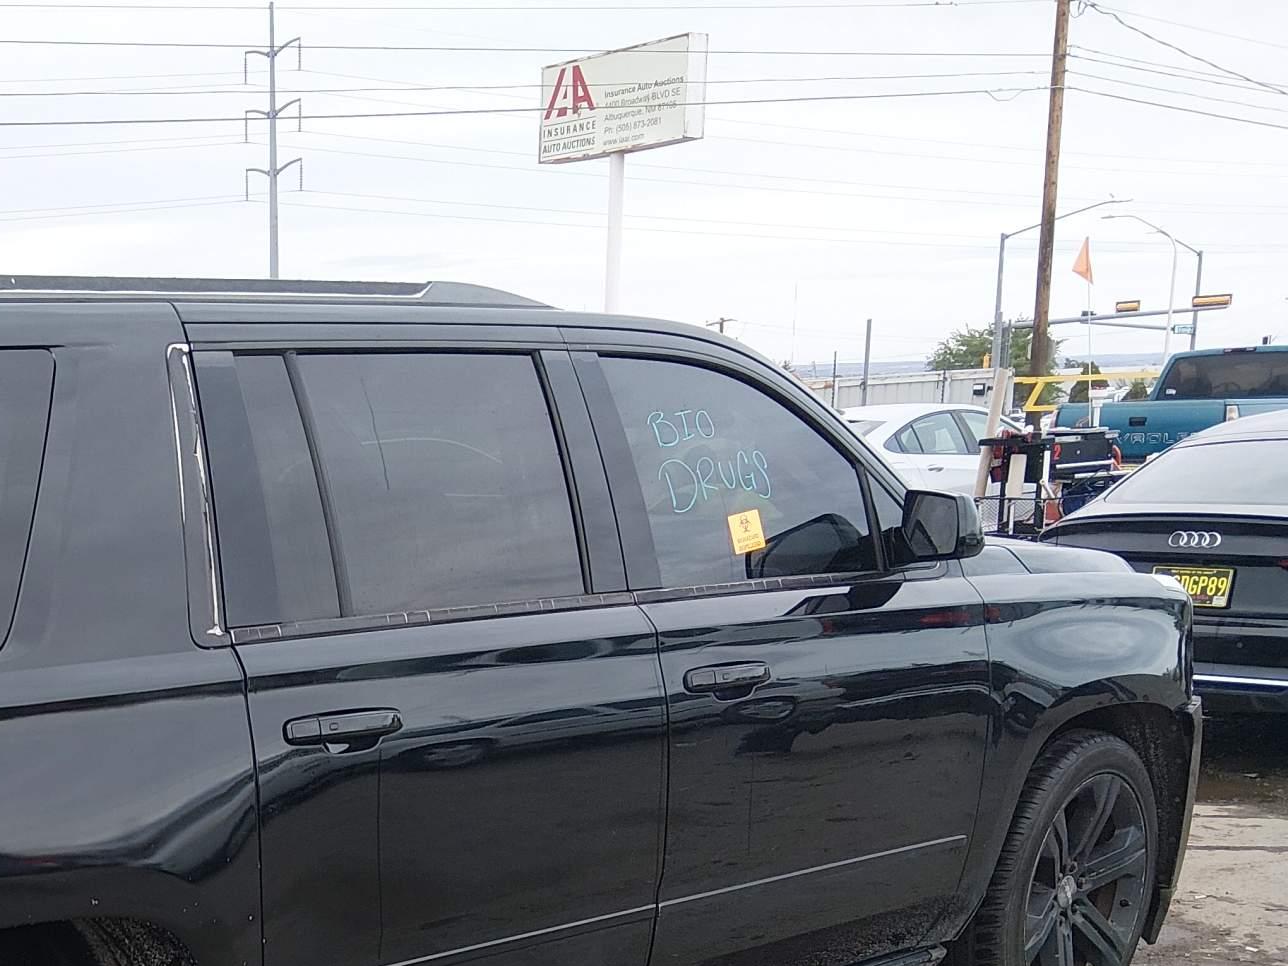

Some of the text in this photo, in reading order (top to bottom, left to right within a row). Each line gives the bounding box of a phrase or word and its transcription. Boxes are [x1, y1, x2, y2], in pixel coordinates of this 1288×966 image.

[604, 76, 684, 99] Insurance Auto Auctions
[651, 89, 670, 101] BLVD
[671, 87, 681, 97] SE
[543, 120, 597, 139] INSURANCE
[542, 136, 596, 154] AUTO AUCTIONS
[647, 410, 715, 447] BIO
[658, 450, 771, 513] DRUGS
[1174, 574, 1228, 596] DGP89
